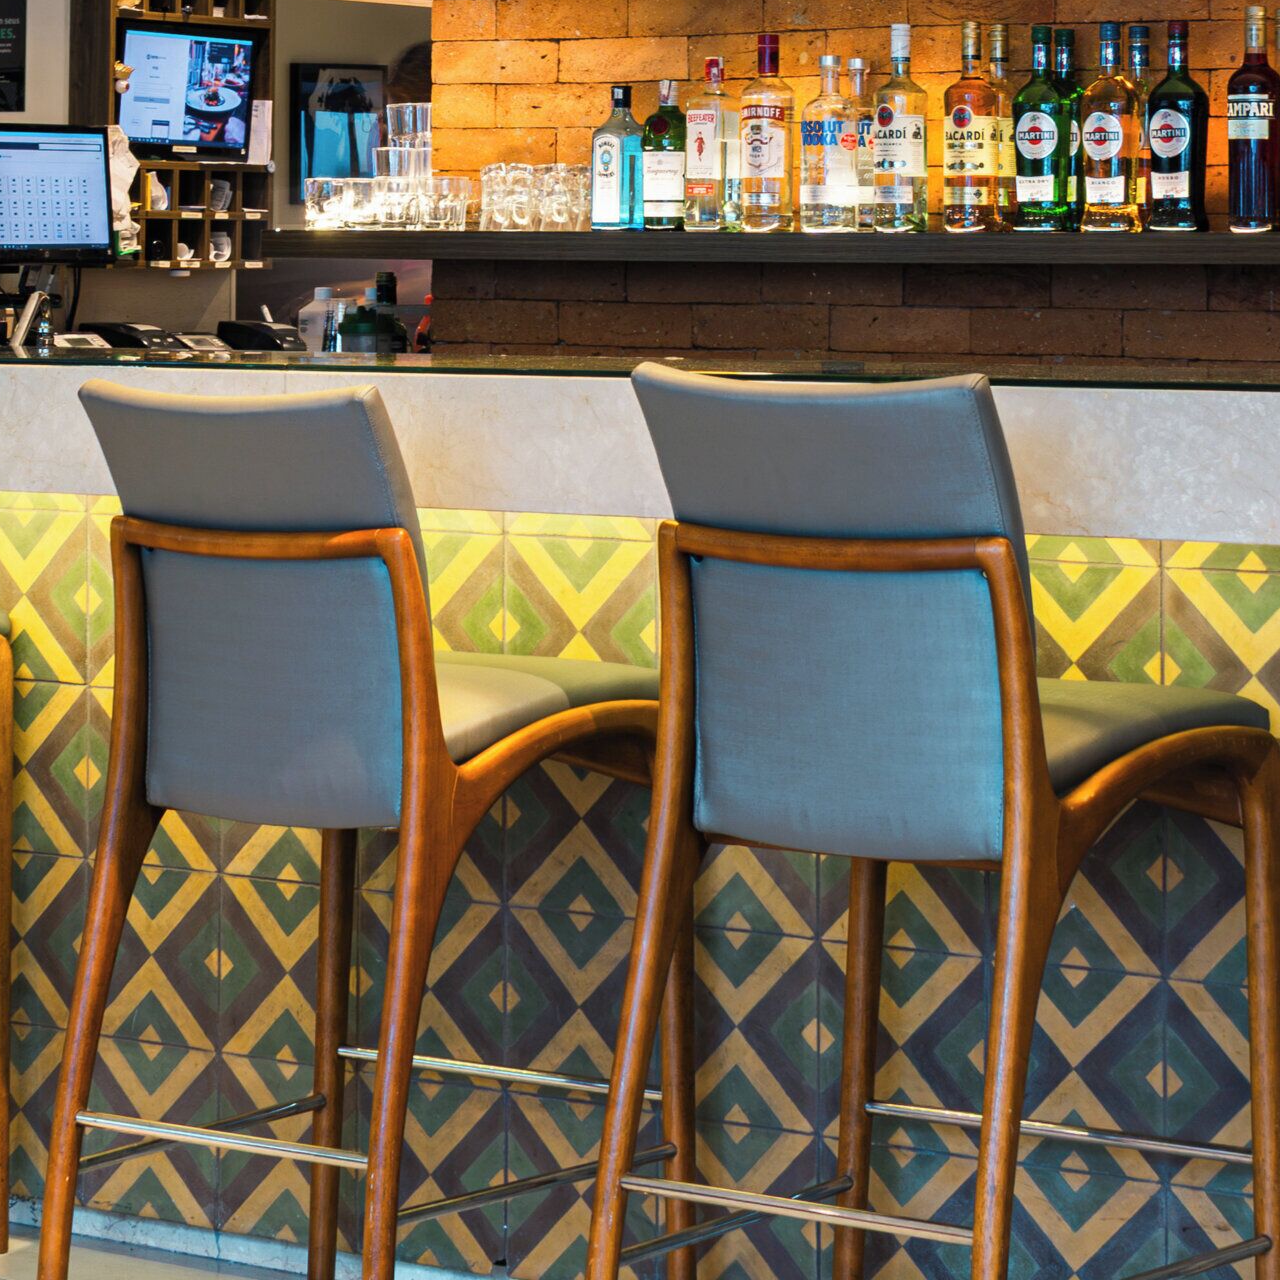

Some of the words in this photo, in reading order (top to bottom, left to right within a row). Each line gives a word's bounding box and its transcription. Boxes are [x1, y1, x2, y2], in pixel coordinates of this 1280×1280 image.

[1227, 102, 1274, 117] AMPARI
[688, 113, 714, 124] BEEFEATER
[801, 120, 844, 134] BSOLUT
[874, 127, 907, 140] ACARDÍ
[1018, 131, 1054, 141] MARTINI
[1084, 131, 1119, 141] MARTINI
[1151, 128, 1186, 139] MARTINI
